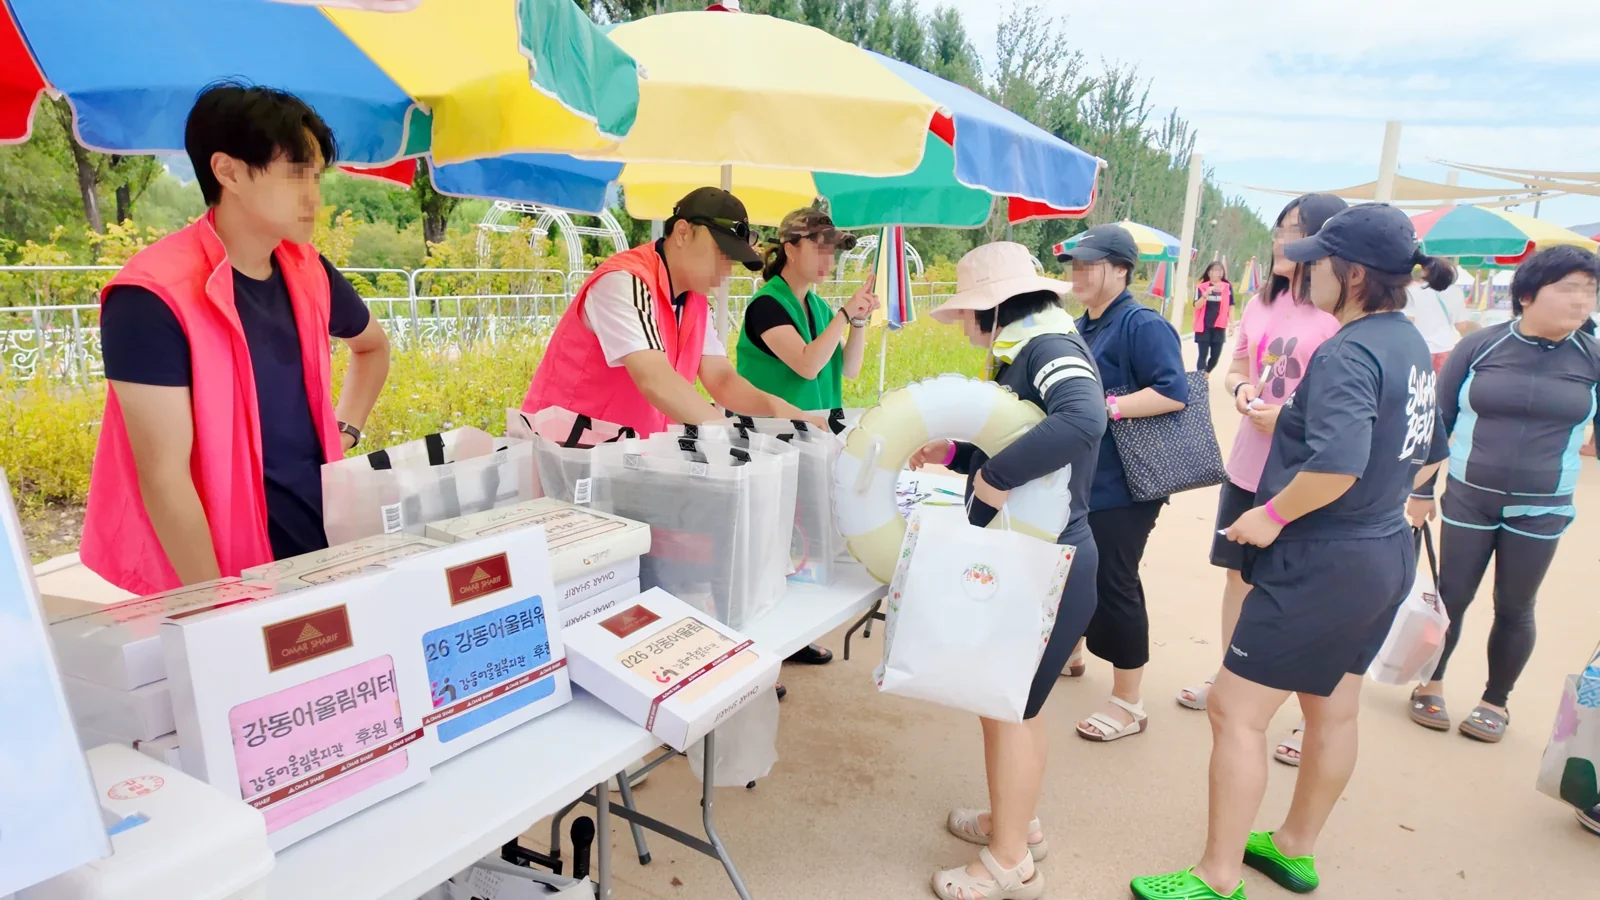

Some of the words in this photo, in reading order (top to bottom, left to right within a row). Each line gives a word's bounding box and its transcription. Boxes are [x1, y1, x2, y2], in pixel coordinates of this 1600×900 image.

[459, 583, 480, 594] OMAR
[480, 575, 502, 589] SHARIF
[564, 580, 591, 600] SHARIF
[593, 570, 615, 587] OMAR
[281, 642, 308, 658] OMAR
[310, 632, 339, 650] SHARIF
[459, 654, 526, 691] 강동어울림복지관
[242, 669, 396, 748] 강동어울림워터
[249, 742, 345, 793] 강동어울림복지관
[355, 719, 389, 746] 후원
